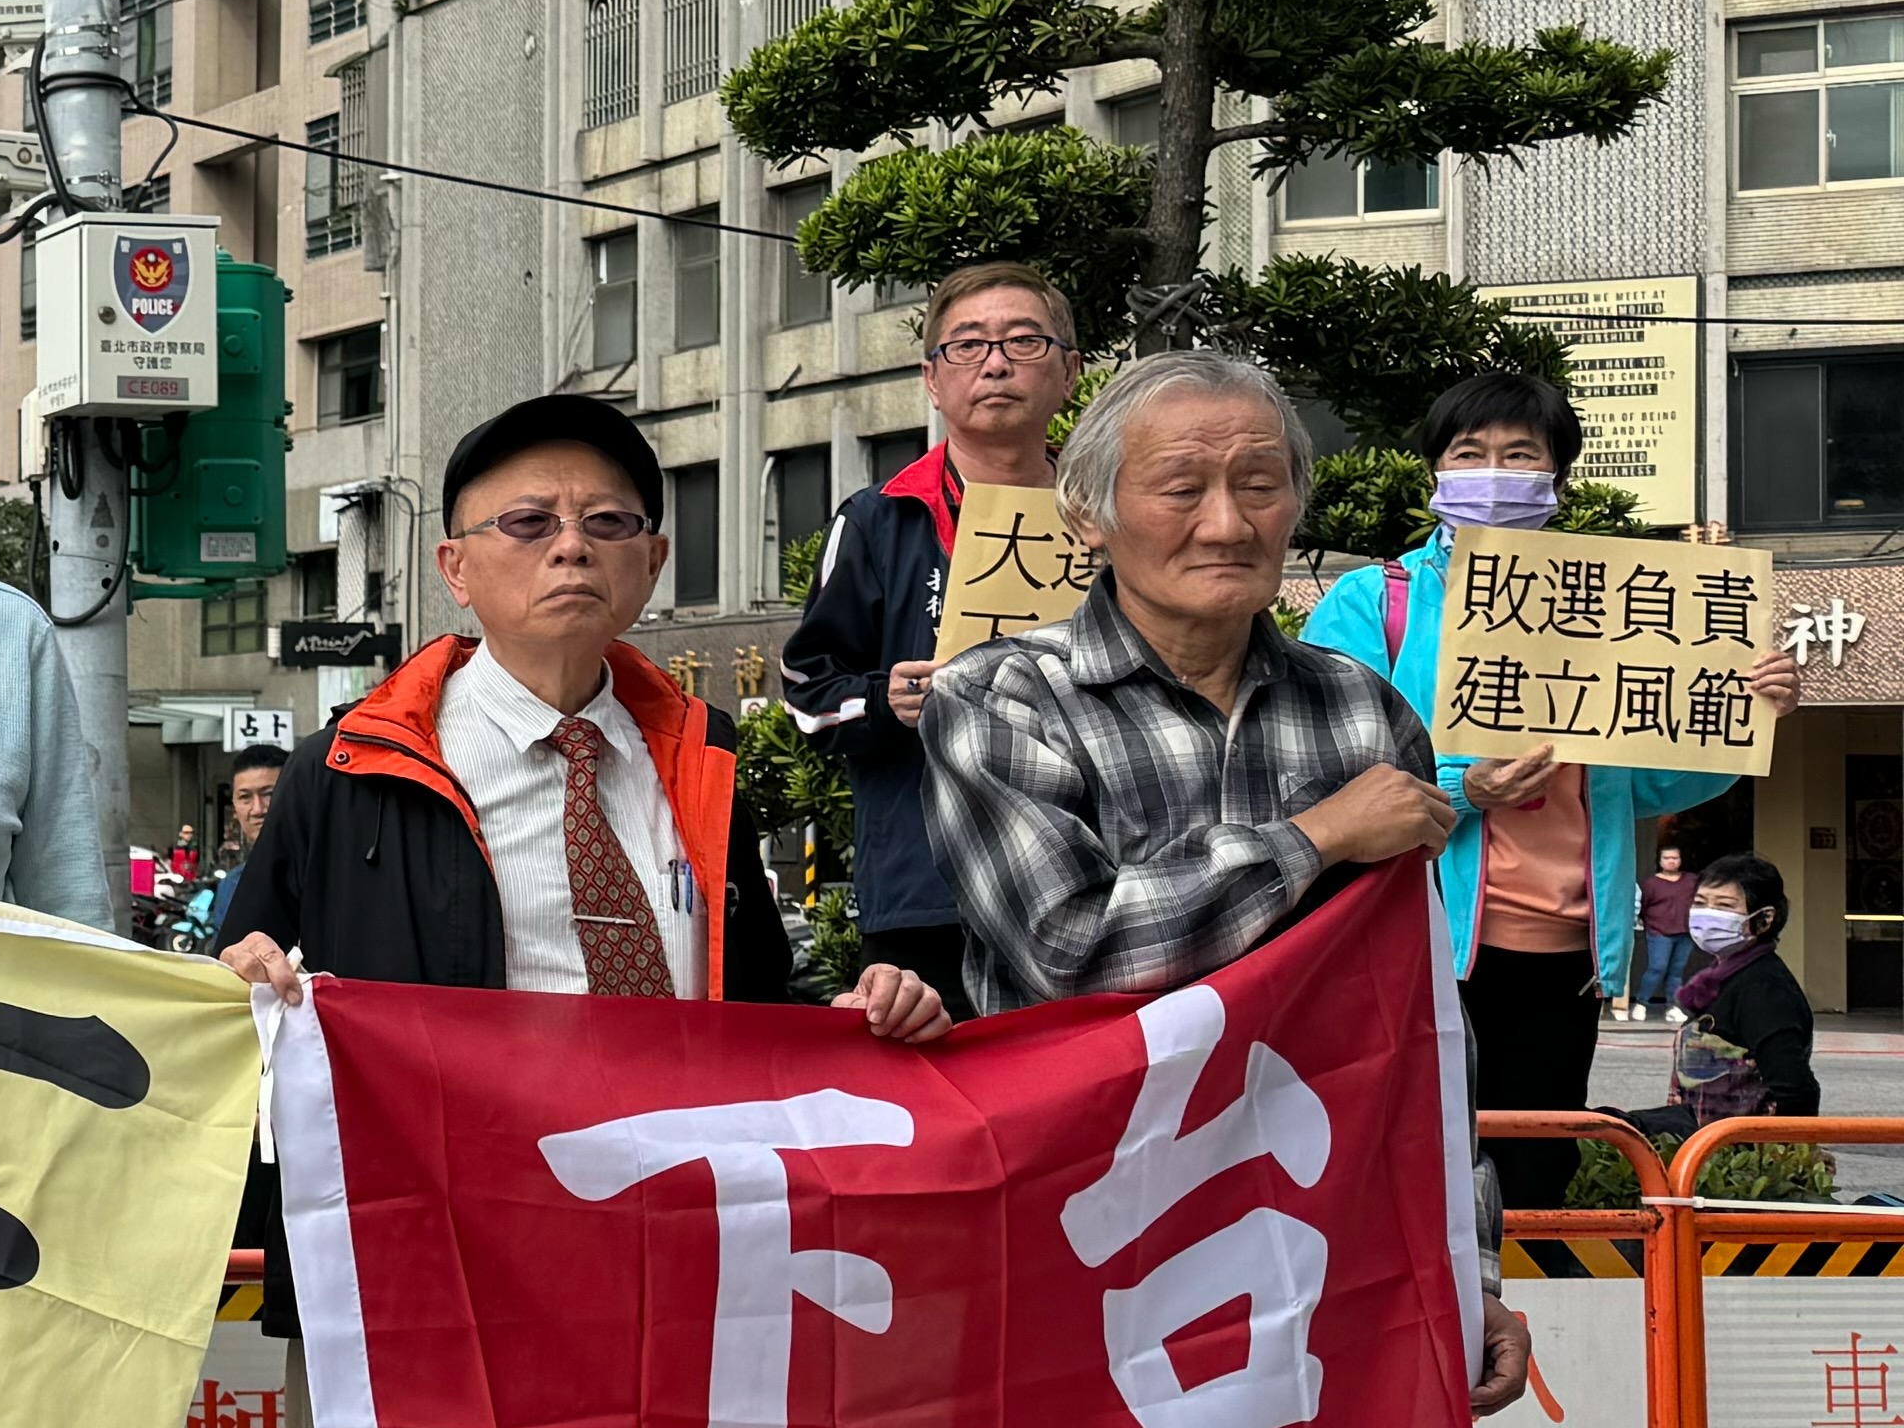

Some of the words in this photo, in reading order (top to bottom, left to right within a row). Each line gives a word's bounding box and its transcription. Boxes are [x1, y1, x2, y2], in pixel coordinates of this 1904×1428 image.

[131, 297, 174, 316] POLICE
[1615, 290, 1647, 302] MEET
[1651, 289, 1666, 300] AT
[100, 339, 206, 356] 臺北市政府警察局
[132, 356, 173, 370] 守護您
[1456, 550, 1759, 650] 敗選負責
[1780, 598, 1868, 669] 神
[1446, 654, 1756, 749] 建立風範
[239, 713, 288, 738] 占卜
